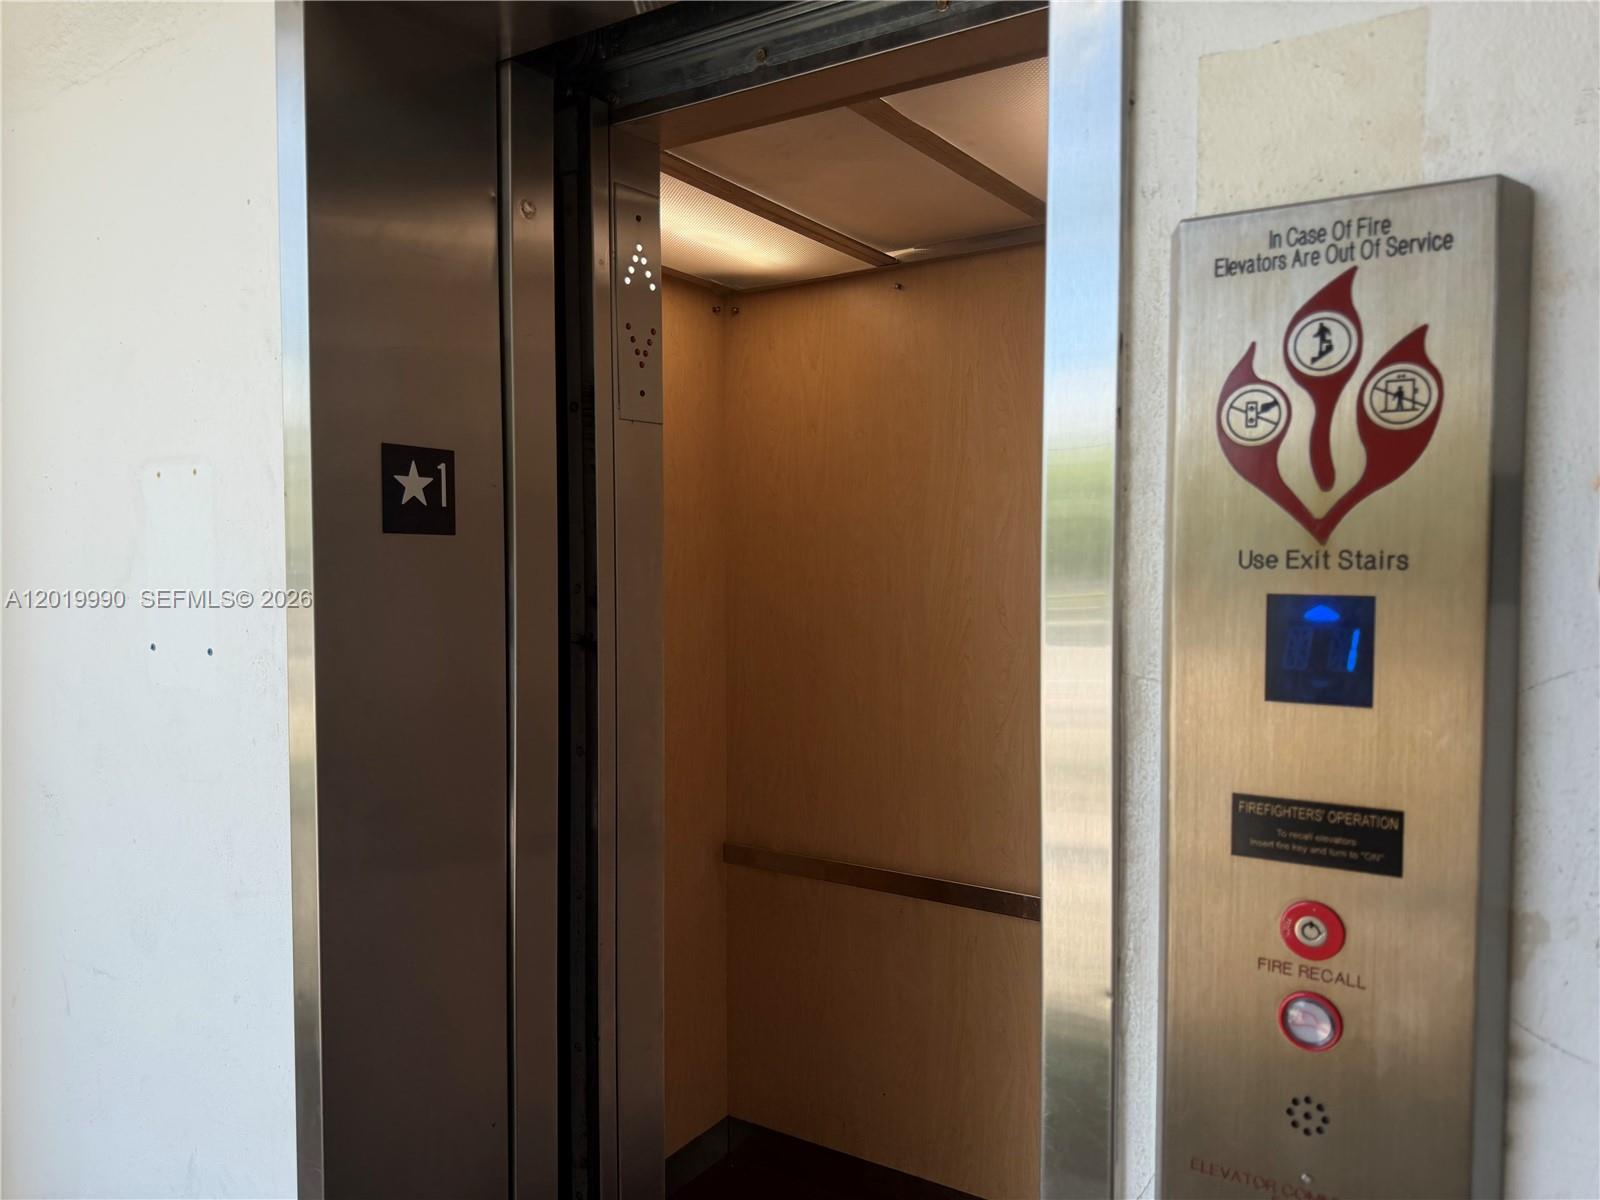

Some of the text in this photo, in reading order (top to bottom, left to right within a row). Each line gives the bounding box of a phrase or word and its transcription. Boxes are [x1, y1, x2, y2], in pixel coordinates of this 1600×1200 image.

[1269, 216, 1392, 249] In Case Of Fire
[1214, 231, 1454, 278] Elevators Are Out Of Service
[437, 462, 447, 507] 1
[1238, 550, 1409, 571] Use Exit Stairs
[1346, 627, 1361, 673] 1
[1277, 828, 1287, 839] To
[1327, 810, 1399, 831] OPERATION
[1257, 957, 1367, 990] FIRE RECALL
[1190, 1156, 1277, 1193] ELEVATOR
